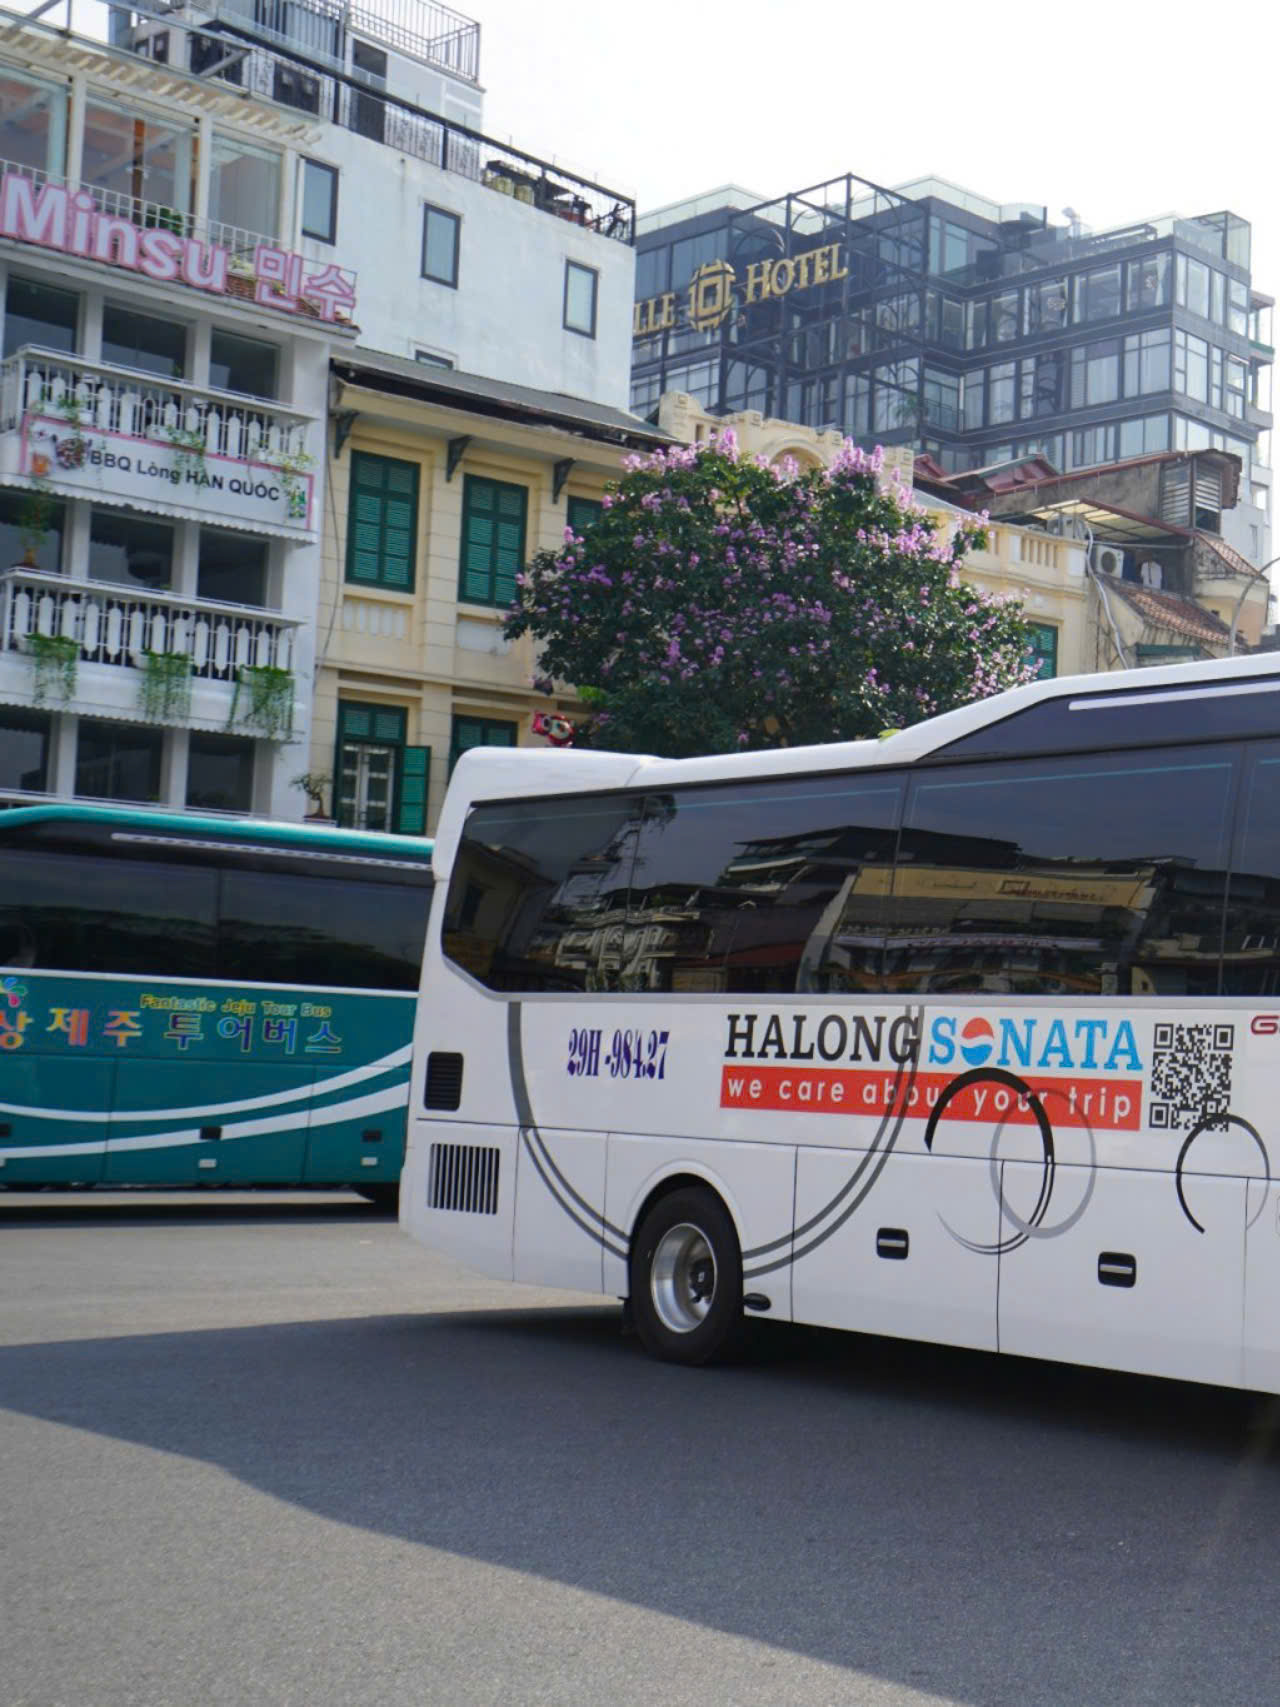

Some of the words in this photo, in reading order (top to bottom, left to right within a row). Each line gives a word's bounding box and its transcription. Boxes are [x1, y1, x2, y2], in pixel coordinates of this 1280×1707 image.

[1, 173, 228, 292] Minsu
[256, 245, 356, 323] 민수
[745, 243, 848, 304] HOTEL
[90, 450, 131, 472] BBQ
[139, 993, 217, 1013] Fantastic
[221, 998, 256, 1016] Jeju
[261, 1000, 297, 1016] Tour
[300, 1002, 333, 1018] Bus
[724, 1014, 922, 1063] HALONG
[727, 1079, 762, 1099] we
[779, 1080, 845, 1102] care
[974, 1089, 1048, 1117] your
[1069, 1087, 1132, 1121] trip
